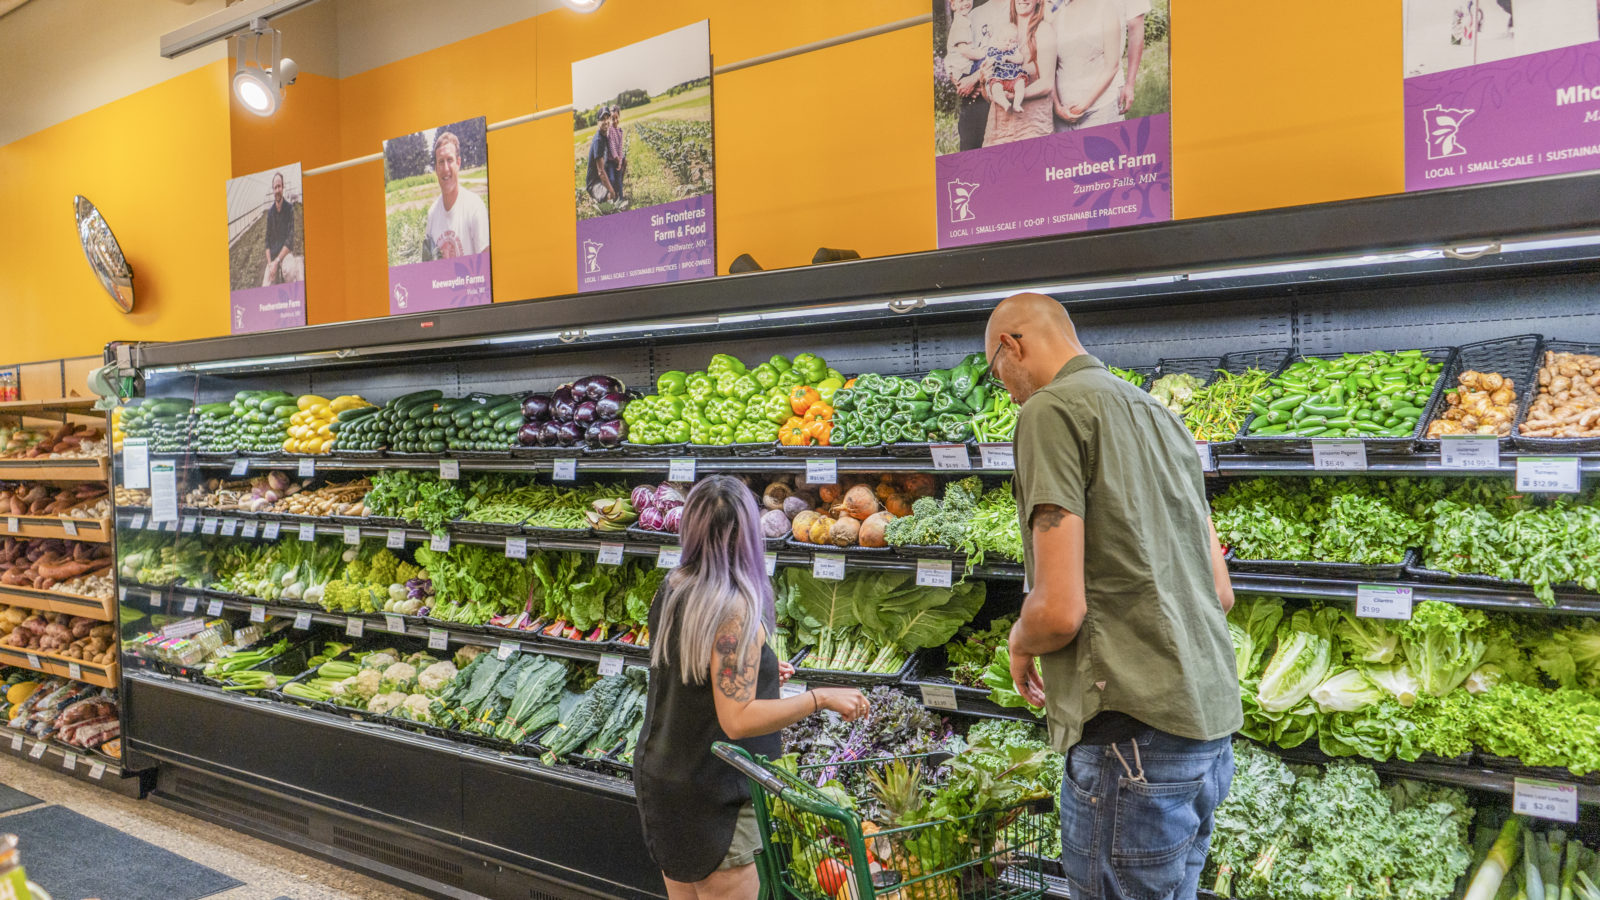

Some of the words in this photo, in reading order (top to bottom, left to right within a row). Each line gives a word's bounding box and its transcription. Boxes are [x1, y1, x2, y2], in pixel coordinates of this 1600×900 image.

[1045, 157, 1115, 182] Heartbeet
[1118, 153, 1156, 170] Farm
[1425, 166, 1456, 180] LOCAL
[1467, 154, 1534, 173] SMALL-SCALE
[1546, 144, 1600, 162] SUSTAINA
[1073, 181, 1111, 194] Zumbro
[1112, 176, 1136, 188] Falls,
[1139, 172, 1158, 185] MN
[650, 213, 664, 227] Sin
[665, 208, 706, 224] Fronteras
[949, 228, 969, 238] LOCAL
[975, 221, 1017, 235] SMALL-SCALE
[1023, 217, 1045, 228] CO-OP
[1052, 209, 1098, 224] SUSTAINABLE
[1098, 204, 1138, 217] PRACTICES
[654, 229, 676, 242] Farm
[677, 226, 683, 238] &
[684, 221, 706, 236] Food
[465, 274, 485, 284] Farms
